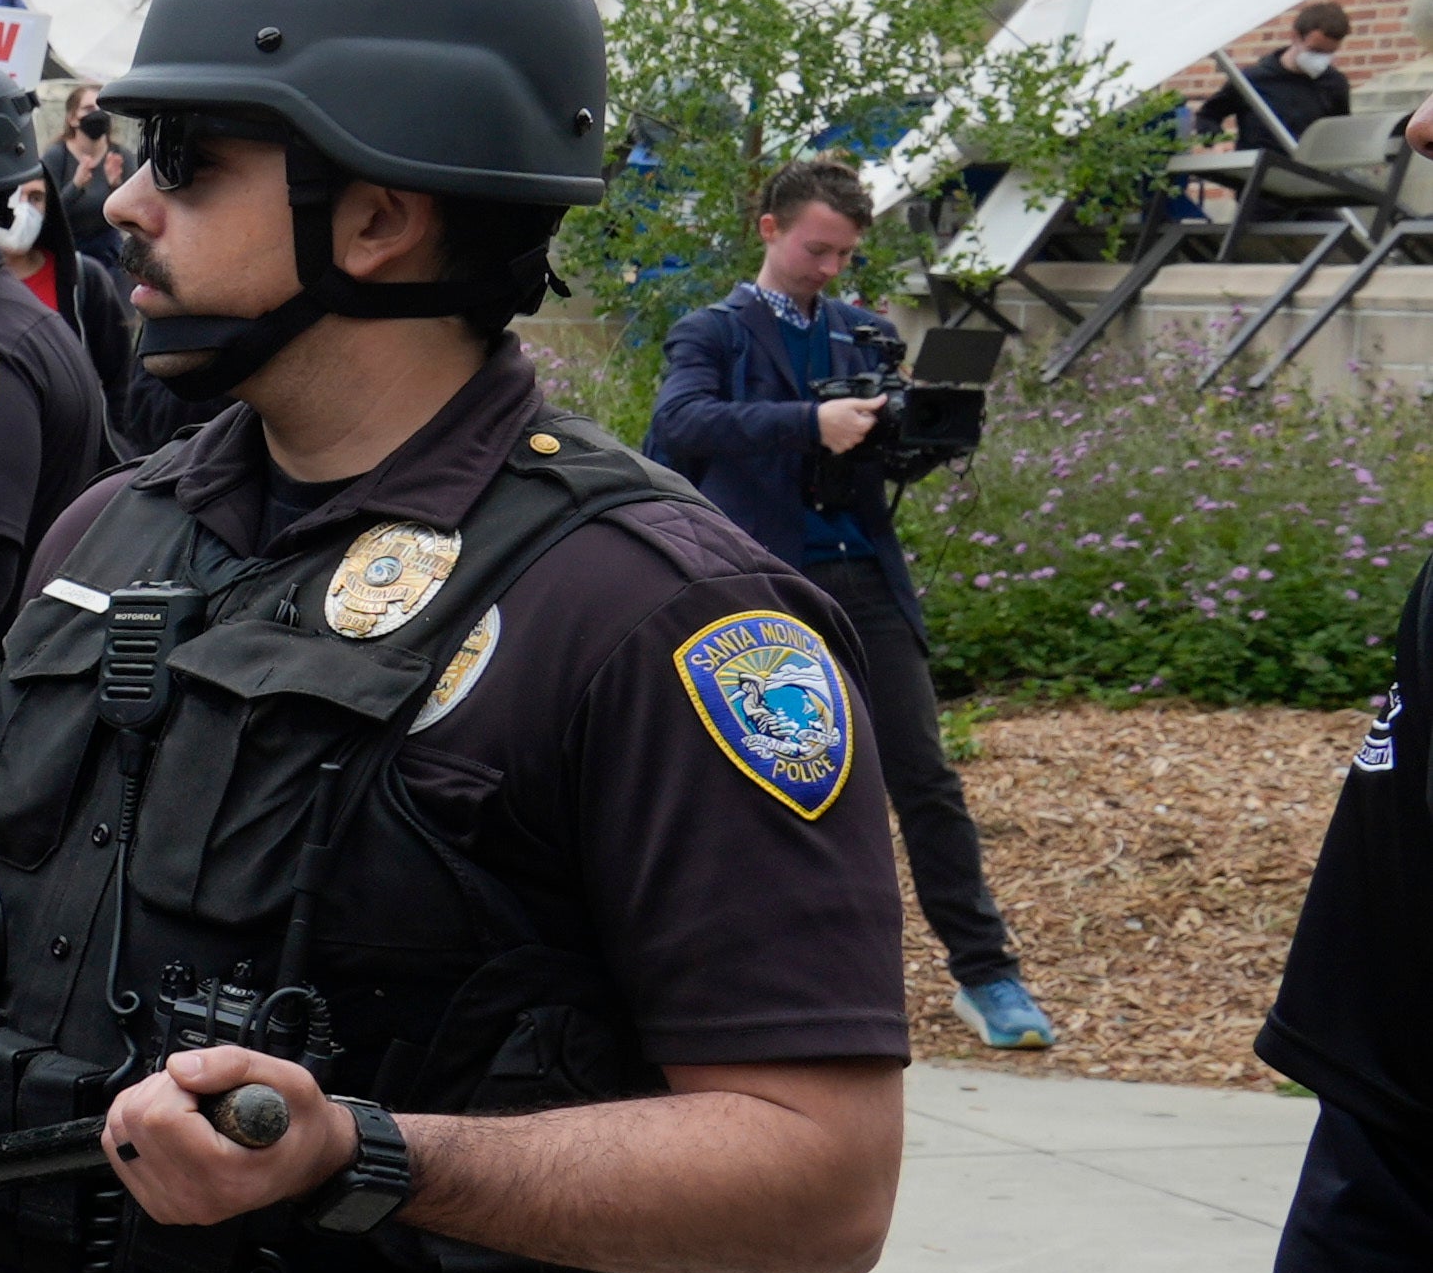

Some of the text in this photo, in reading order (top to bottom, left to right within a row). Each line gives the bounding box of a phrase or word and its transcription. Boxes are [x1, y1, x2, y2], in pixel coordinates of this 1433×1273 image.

[114, 613, 162, 621] MOTOROLA
[690, 622, 824, 671] SANTA MONICA
[772, 753, 835, 783] POLICE
